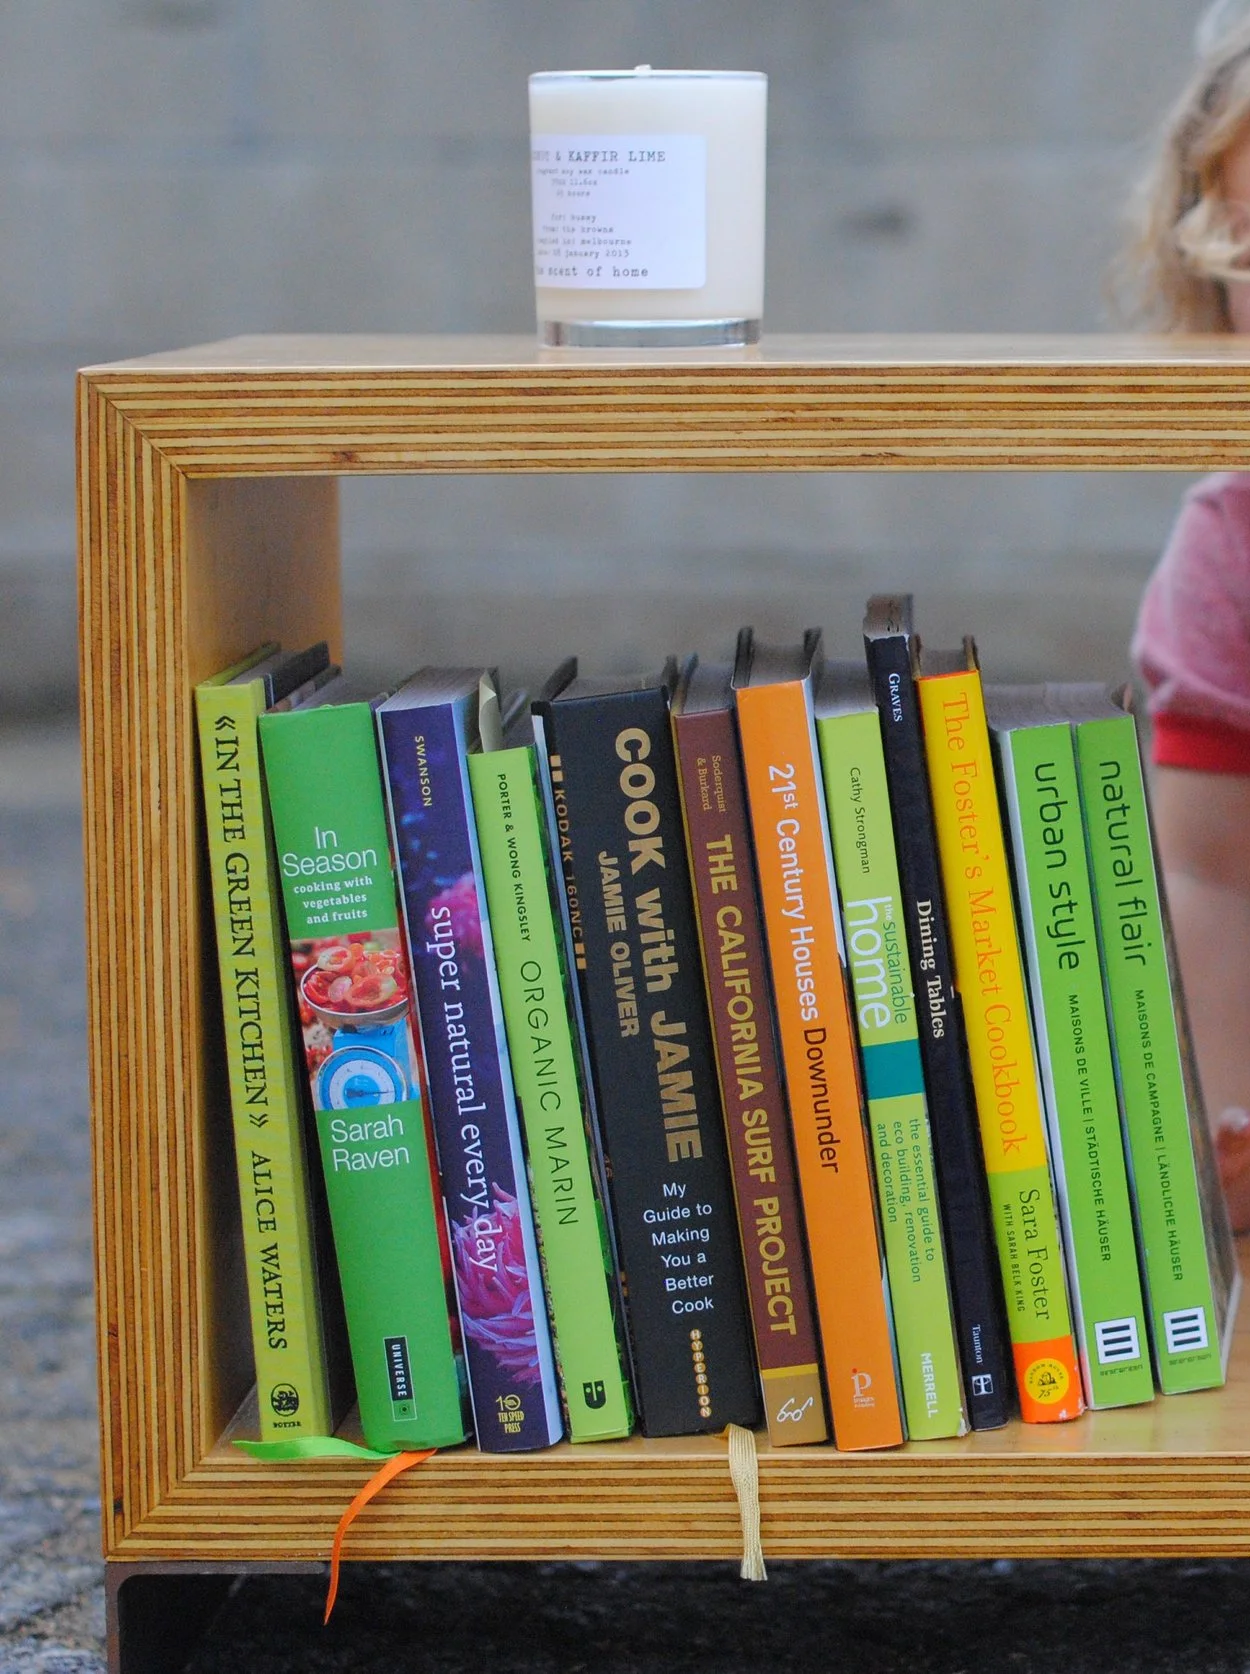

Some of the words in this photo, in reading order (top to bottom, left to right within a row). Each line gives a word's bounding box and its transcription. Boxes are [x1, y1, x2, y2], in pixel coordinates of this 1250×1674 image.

[568, 150, 618, 162] KAFFIR
[628, 150, 666, 162] LIME
[547, 266, 578, 277] scent
[586, 266, 603, 277] of
[612, 265, 649, 277] home
[943, 692, 970, 751] The
[215, 737, 239, 771] IN
[414, 735, 433, 807] SWANSON
[697, 757, 707, 767] &
[219, 779, 246, 843] THE
[497, 773, 512, 819] PORTER
[698, 768, 713, 811] Burkard
[712, 755, 727, 812] Soderquist
[768, 763, 798, 810] 21st
[850, 767, 863, 803] Cathy
[314, 826, 338, 850] In
[506, 824, 514, 832] &
[553, 789, 574, 862] KODAK
[855, 807, 870, 874] Strongman
[1034, 761, 1068, 870] urban
[1099, 760, 1143, 888] natural
[283, 846, 377, 877] Season
[293, 880, 342, 895] cooking
[343, 875, 373, 888] with
[507, 837, 521, 878] WONG
[705, 834, 738, 895] THE
[776, 817, 805, 920] Century
[225, 852, 256, 958] GREEN
[302, 893, 367, 909] vegetables
[306, 912, 329, 925] and
[332, 908, 368, 923] fruits
[514, 882, 531, 942] KINGSLEY
[597, 850, 627, 933] JAMIE
[884, 904, 894, 921] the
[427, 906, 461, 991] super
[614, 727, 665, 876] COOK
[650, 1010, 703, 1163] JAMIE
[968, 887, 1002, 996] Market
[1046, 880, 1086, 971] style
[1117, 896, 1153, 967] flair
[610, 942, 640, 1038] OLIVER
[789, 924, 819, 1020] Houses
[846, 896, 892, 1029] home
[883, 921, 911, 1024] sustainable
[916, 899, 938, 971] Dining
[927, 975, 947, 1039] Tables
[716, 905, 765, 1101] CALIFORNIA
[1068, 994, 1085, 1055] MAISONS
[1134, 989, 1151, 1049] MAISONS
[234, 967, 269, 1106] KITCHEN
[445, 1001, 486, 1116] natural
[1142, 1052, 1155, 1069] DE
[520, 960, 562, 1112] ORGANIC
[544, 1126, 579, 1226] MARIN
[984, 1003, 1028, 1155] Cookbook
[1076, 1058, 1088, 1076] DE
[803, 1028, 840, 1173] Downunder
[1079, 1078, 1093, 1116] VILLE
[1146, 1072, 1165, 1144] CAMPAGNE
[330, 1114, 404, 1144] Sarah
[741, 1108, 776, 1183] SURF
[877, 1123, 890, 1147] and
[893, 1121, 903, 1145] eco
[909, 1119, 920, 1140] the
[333, 1145, 409, 1172] Raven
[460, 1123, 489, 1209] every
[896, 1149, 911, 1207] building,
[913, 1146, 930, 1202] essential
[1085, 1126, 1105, 1205] STÄDTISCHE
[251, 1151, 277, 1233] ALICE
[643, 1206, 691, 1223] Guide
[696, 1203, 713, 1216] to
[663, 1183, 687, 1198] My
[881, 1152, 898, 1223] decoration
[1003, 1203, 1013, 1226] WITH
[1019, 1189, 1040, 1242] Sara
[1157, 1154, 1176, 1227] LÄNDLICHE
[469, 1218, 503, 1272] day
[652, 1227, 710, 1247] Making
[904, 1211, 921, 1283] renovation
[917, 1207, 934, 1244] guide
[1007, 1230, 1018, 1260] SARAH
[1096, 1209, 1112, 1262] HÄUSER
[661, 1252, 691, 1268] You
[697, 1253, 707, 1264] a
[665, 1273, 714, 1291] Better
[754, 1196, 798, 1337] PROJECT
[925, 1247, 934, 1262] to
[1011, 1263, 1022, 1286] BELK
[1027, 1245, 1050, 1320] Foster
[1167, 1230, 1183, 1282] HÄUSER
[260, 1243, 288, 1350] WATERS
[671, 1297, 714, 1315] Cook
[1015, 1290, 1025, 1312] KING
[391, 1343, 407, 1397] UNIVERSE
[972, 1324, 983, 1363] Taunton
[689, 1329, 712, 1418] HYPERION
[920, 1352, 939, 1418] MERRELL
[504, 1422, 521, 1433] PRESS
[508, 1410, 524, 1422] SPEED
